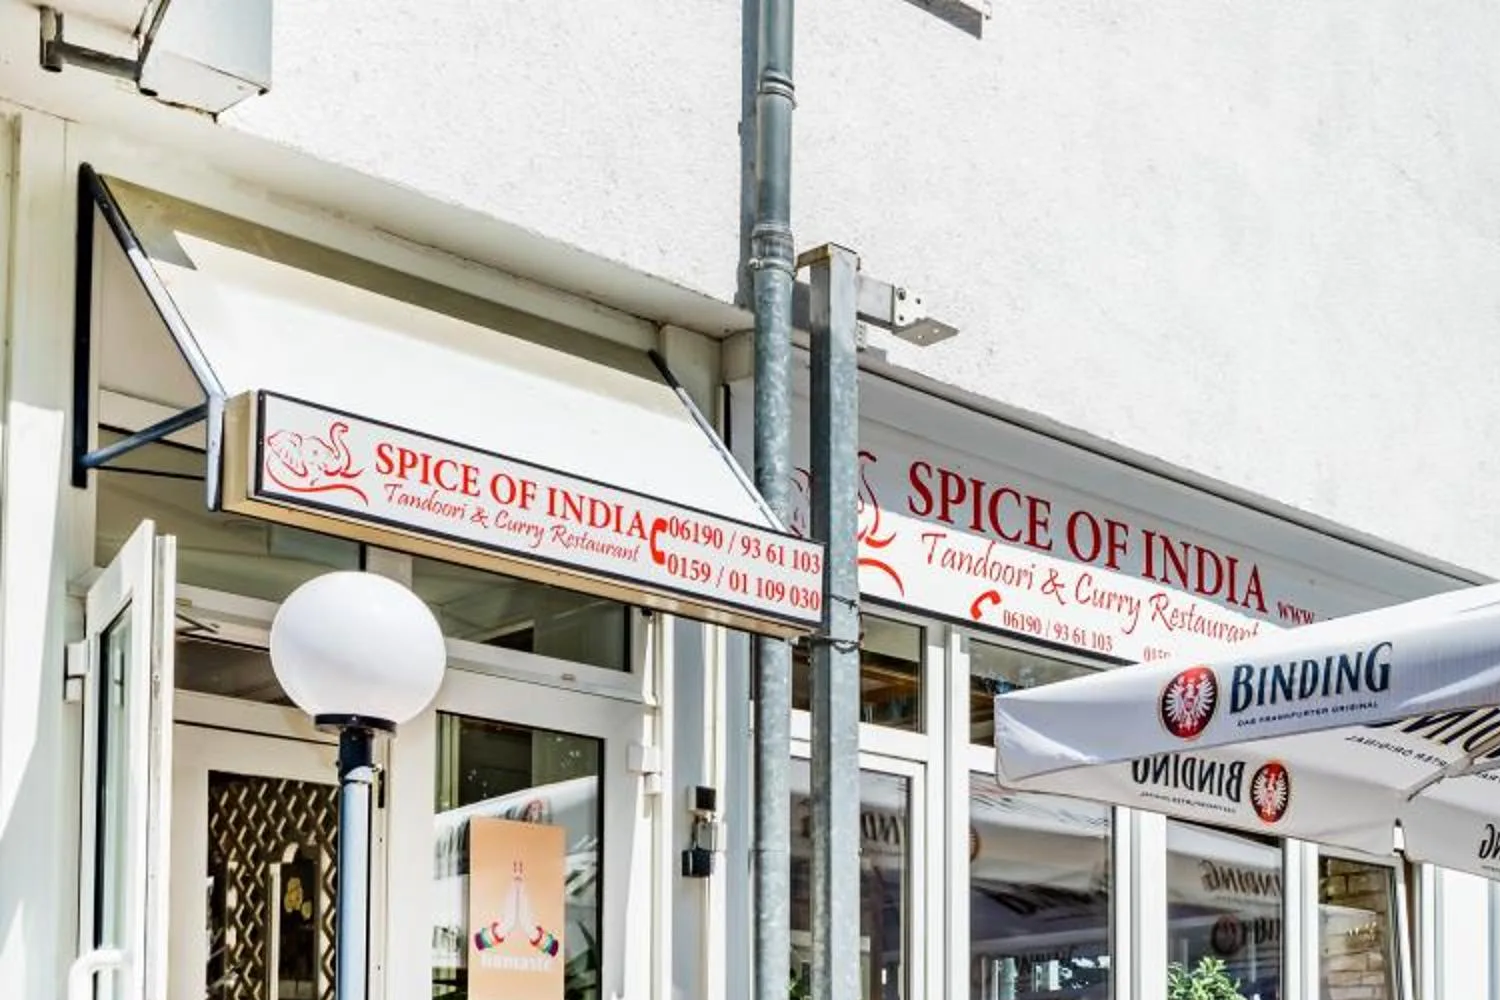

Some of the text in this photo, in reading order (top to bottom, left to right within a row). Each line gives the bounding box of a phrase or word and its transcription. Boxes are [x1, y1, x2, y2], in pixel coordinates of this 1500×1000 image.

[375, 443, 648, 541] SPICE OF INDIA
[384, 483, 641, 562] Tandoori & Curry Restaurant
[668, 515, 821, 575] 06190 / 93 61 103
[907, 461, 1269, 613] SPICE OF INDIA
[667, 553, 821, 611] 0159 / 01 109 030
[922, 533, 1260, 644] Tandoori & Curry Restaurant
[1003, 609, 1042, 636] 06190
[1053, 622, 1069, 642] 93
[1072, 628, 1087, 647] 61
[1092, 634, 1113, 652] 103
[1230, 641, 1393, 715] BINDING
